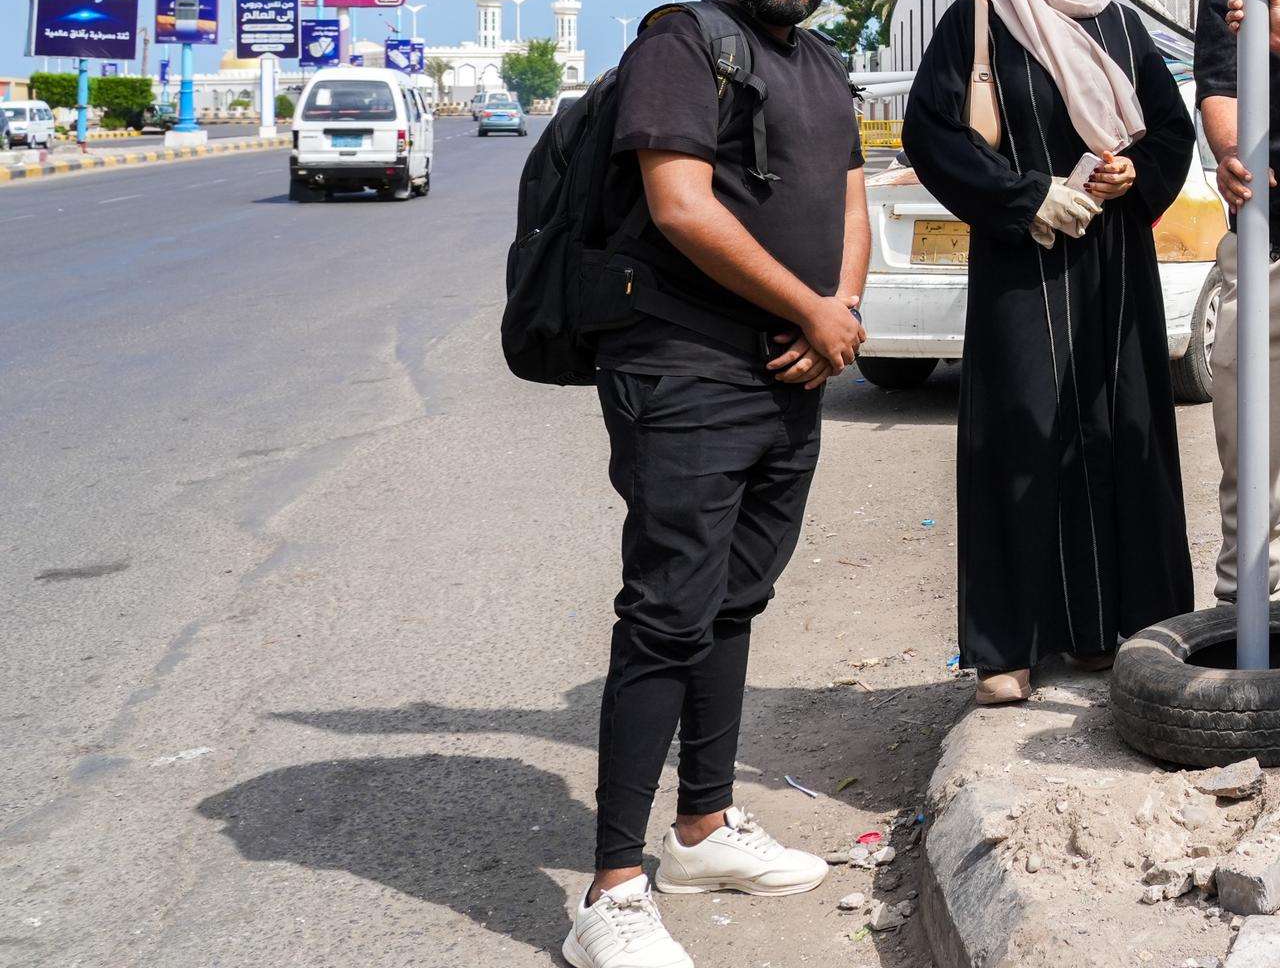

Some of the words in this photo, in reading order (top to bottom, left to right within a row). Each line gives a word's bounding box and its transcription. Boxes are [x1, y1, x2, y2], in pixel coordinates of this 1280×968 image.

[241, 10, 275, 22] العالم
[276, 10, 294, 22] إلى
[44, 28, 69, 38] عالمية
[89, 31, 116, 40] مصرفية
[116, 31, 130, 40] ثقة
